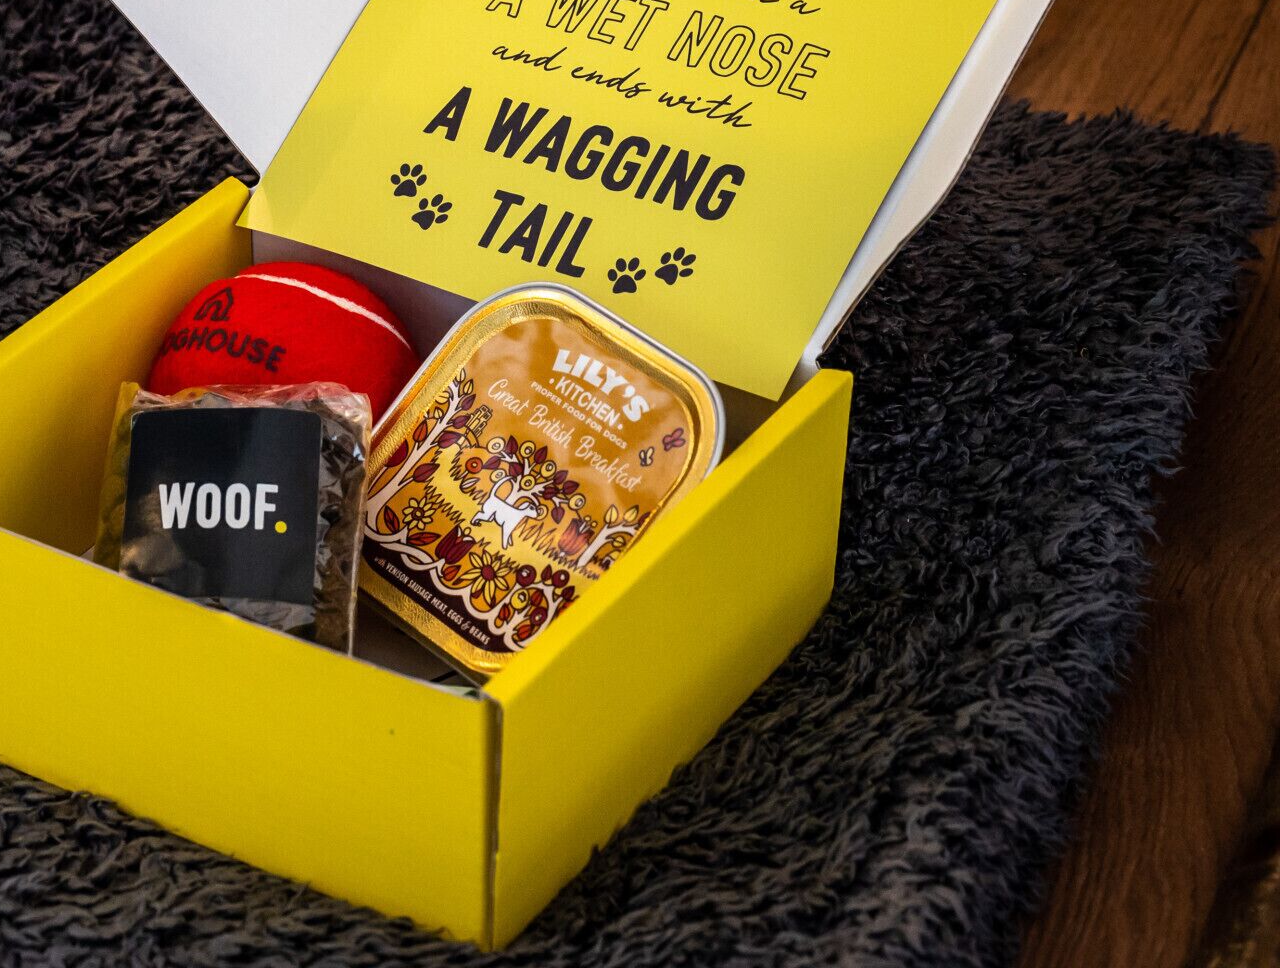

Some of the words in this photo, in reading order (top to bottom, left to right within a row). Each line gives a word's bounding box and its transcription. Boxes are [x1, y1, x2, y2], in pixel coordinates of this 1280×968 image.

[491, 45, 567, 72] and
[570, 62, 652, 99] ends
[657, 86, 752, 129] with
[667, 10, 831, 100] NOSE
[423, 86, 472, 141] A
[483, 97, 746, 221] WAGGING
[477, 189, 593, 278] TAIL
[160, 326, 286, 372] OGHOUSE
[552, 348, 650, 422] LILY'S
[487, 378, 529, 416] Great
[528, 404, 575, 449] British
[574, 435, 643, 492] Breakfast
[530, 381, 561, 406] PROPER
[562, 402, 586, 422] FOOD
[586, 417, 603, 433] FOR
[603, 430, 627, 450] DOGS
[554, 376, 620, 428] KITCHEN
[158, 482, 288, 534] WOOF.
[385, 562, 410, 584] VENISON
[408, 579, 433, 602] SAUSAGE
[431, 597, 448, 615] MEAT,
[447, 609, 464, 626] EGGS
[469, 625, 491, 645] BEANS
